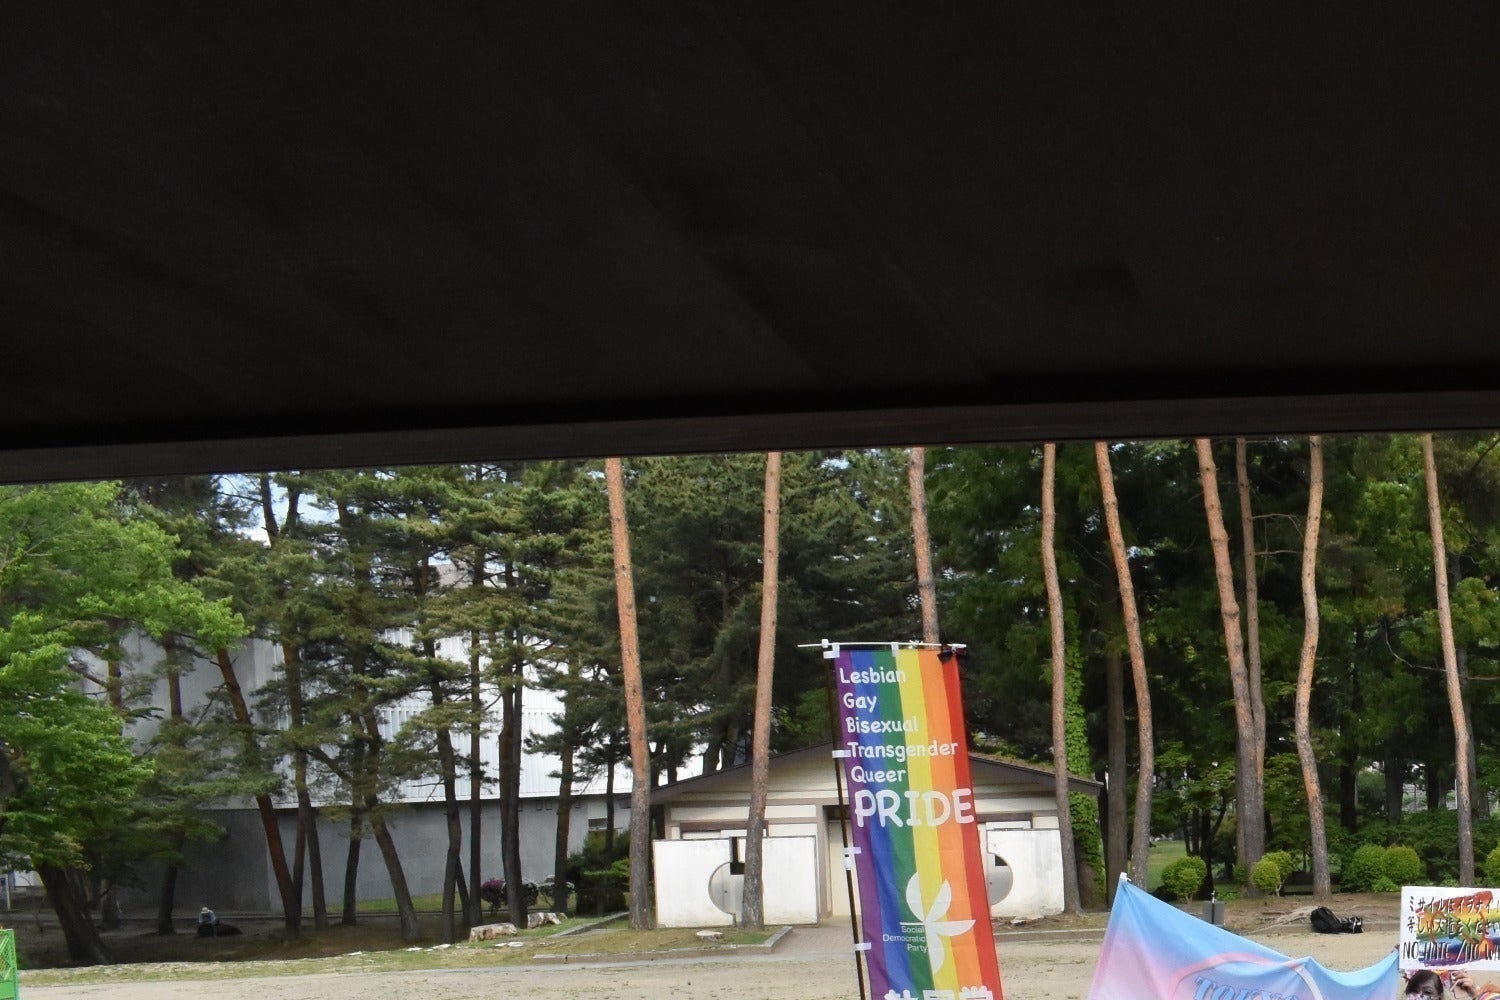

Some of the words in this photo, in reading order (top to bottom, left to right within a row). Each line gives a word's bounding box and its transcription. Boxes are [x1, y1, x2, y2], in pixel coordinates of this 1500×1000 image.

[839, 667, 907, 684] Lesbian
[843, 692, 877, 712] Gay
[846, 716, 918, 733] Bisexual
[847, 740, 958, 763] Transgender
[850, 766, 906, 783] Queer
[854, 787, 975, 828] PRIDE
[901, 925, 925, 934] Social
[882, 934, 926, 943] Democratic
[907, 944, 928, 953] Party
[1403, 941, 1418, 960] NO
